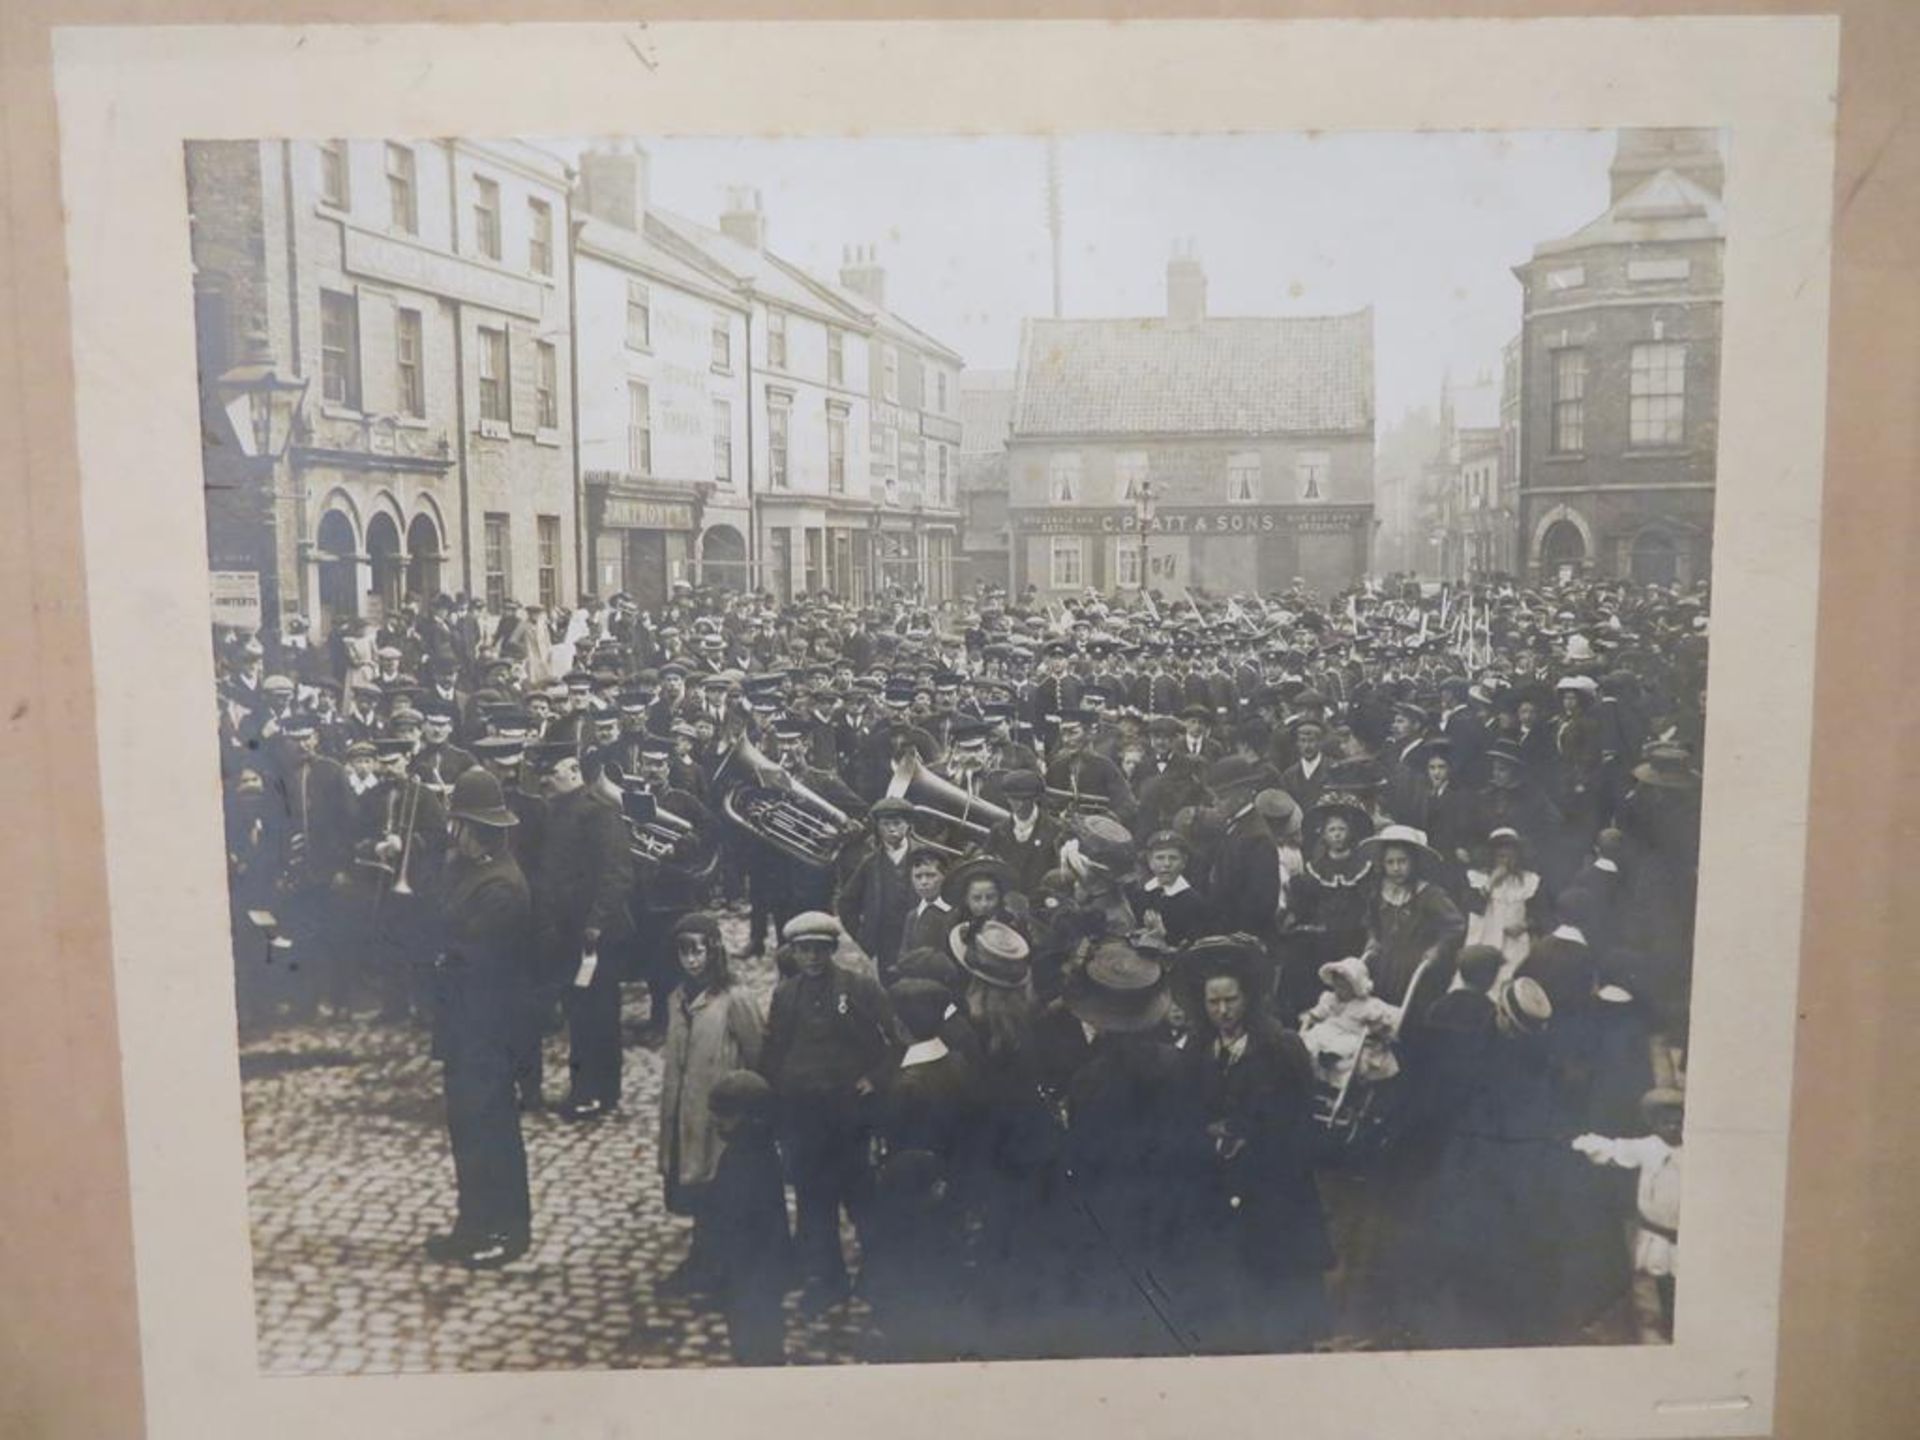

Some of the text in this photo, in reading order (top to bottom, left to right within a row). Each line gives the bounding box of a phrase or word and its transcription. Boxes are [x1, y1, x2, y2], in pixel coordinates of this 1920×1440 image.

[1102, 516, 1119, 532] C.
[1195, 516, 1207, 531] &
[1216, 515, 1274, 531] SONS
